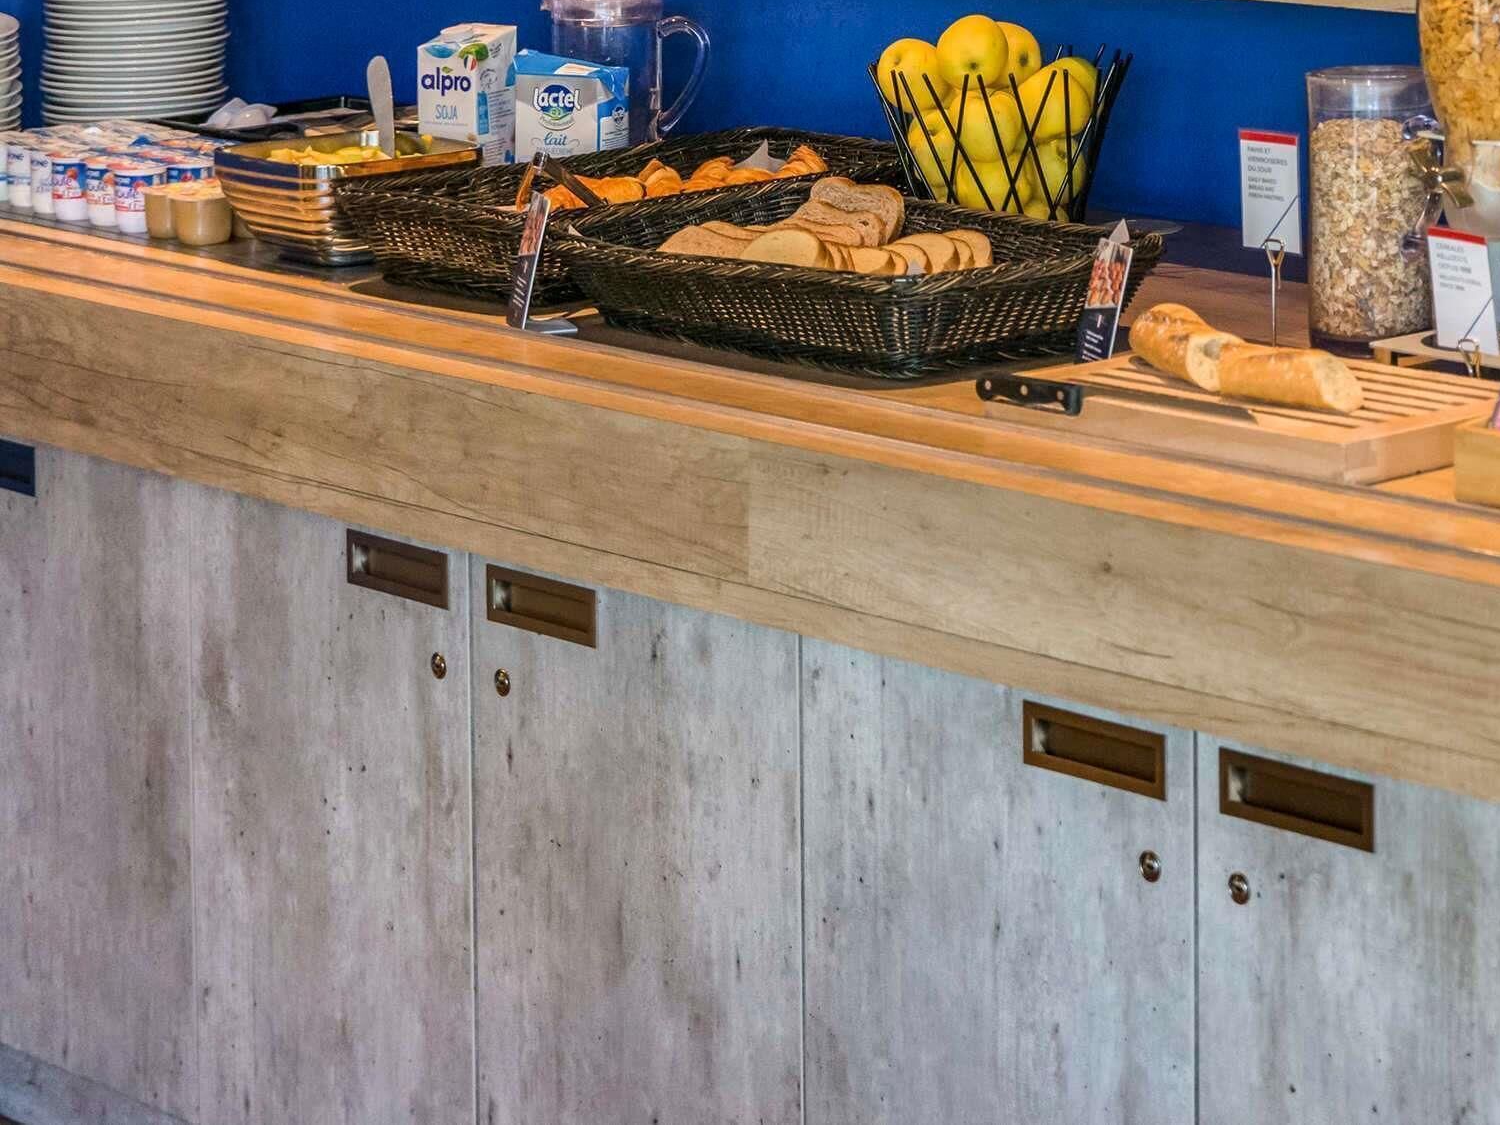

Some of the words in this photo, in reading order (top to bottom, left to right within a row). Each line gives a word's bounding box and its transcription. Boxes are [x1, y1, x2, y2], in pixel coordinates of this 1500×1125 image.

[421, 67, 471, 96] alpro
[533, 87, 583, 111] lactel
[435, 104, 458, 120] SOJA
[543, 132, 568, 146] lait
